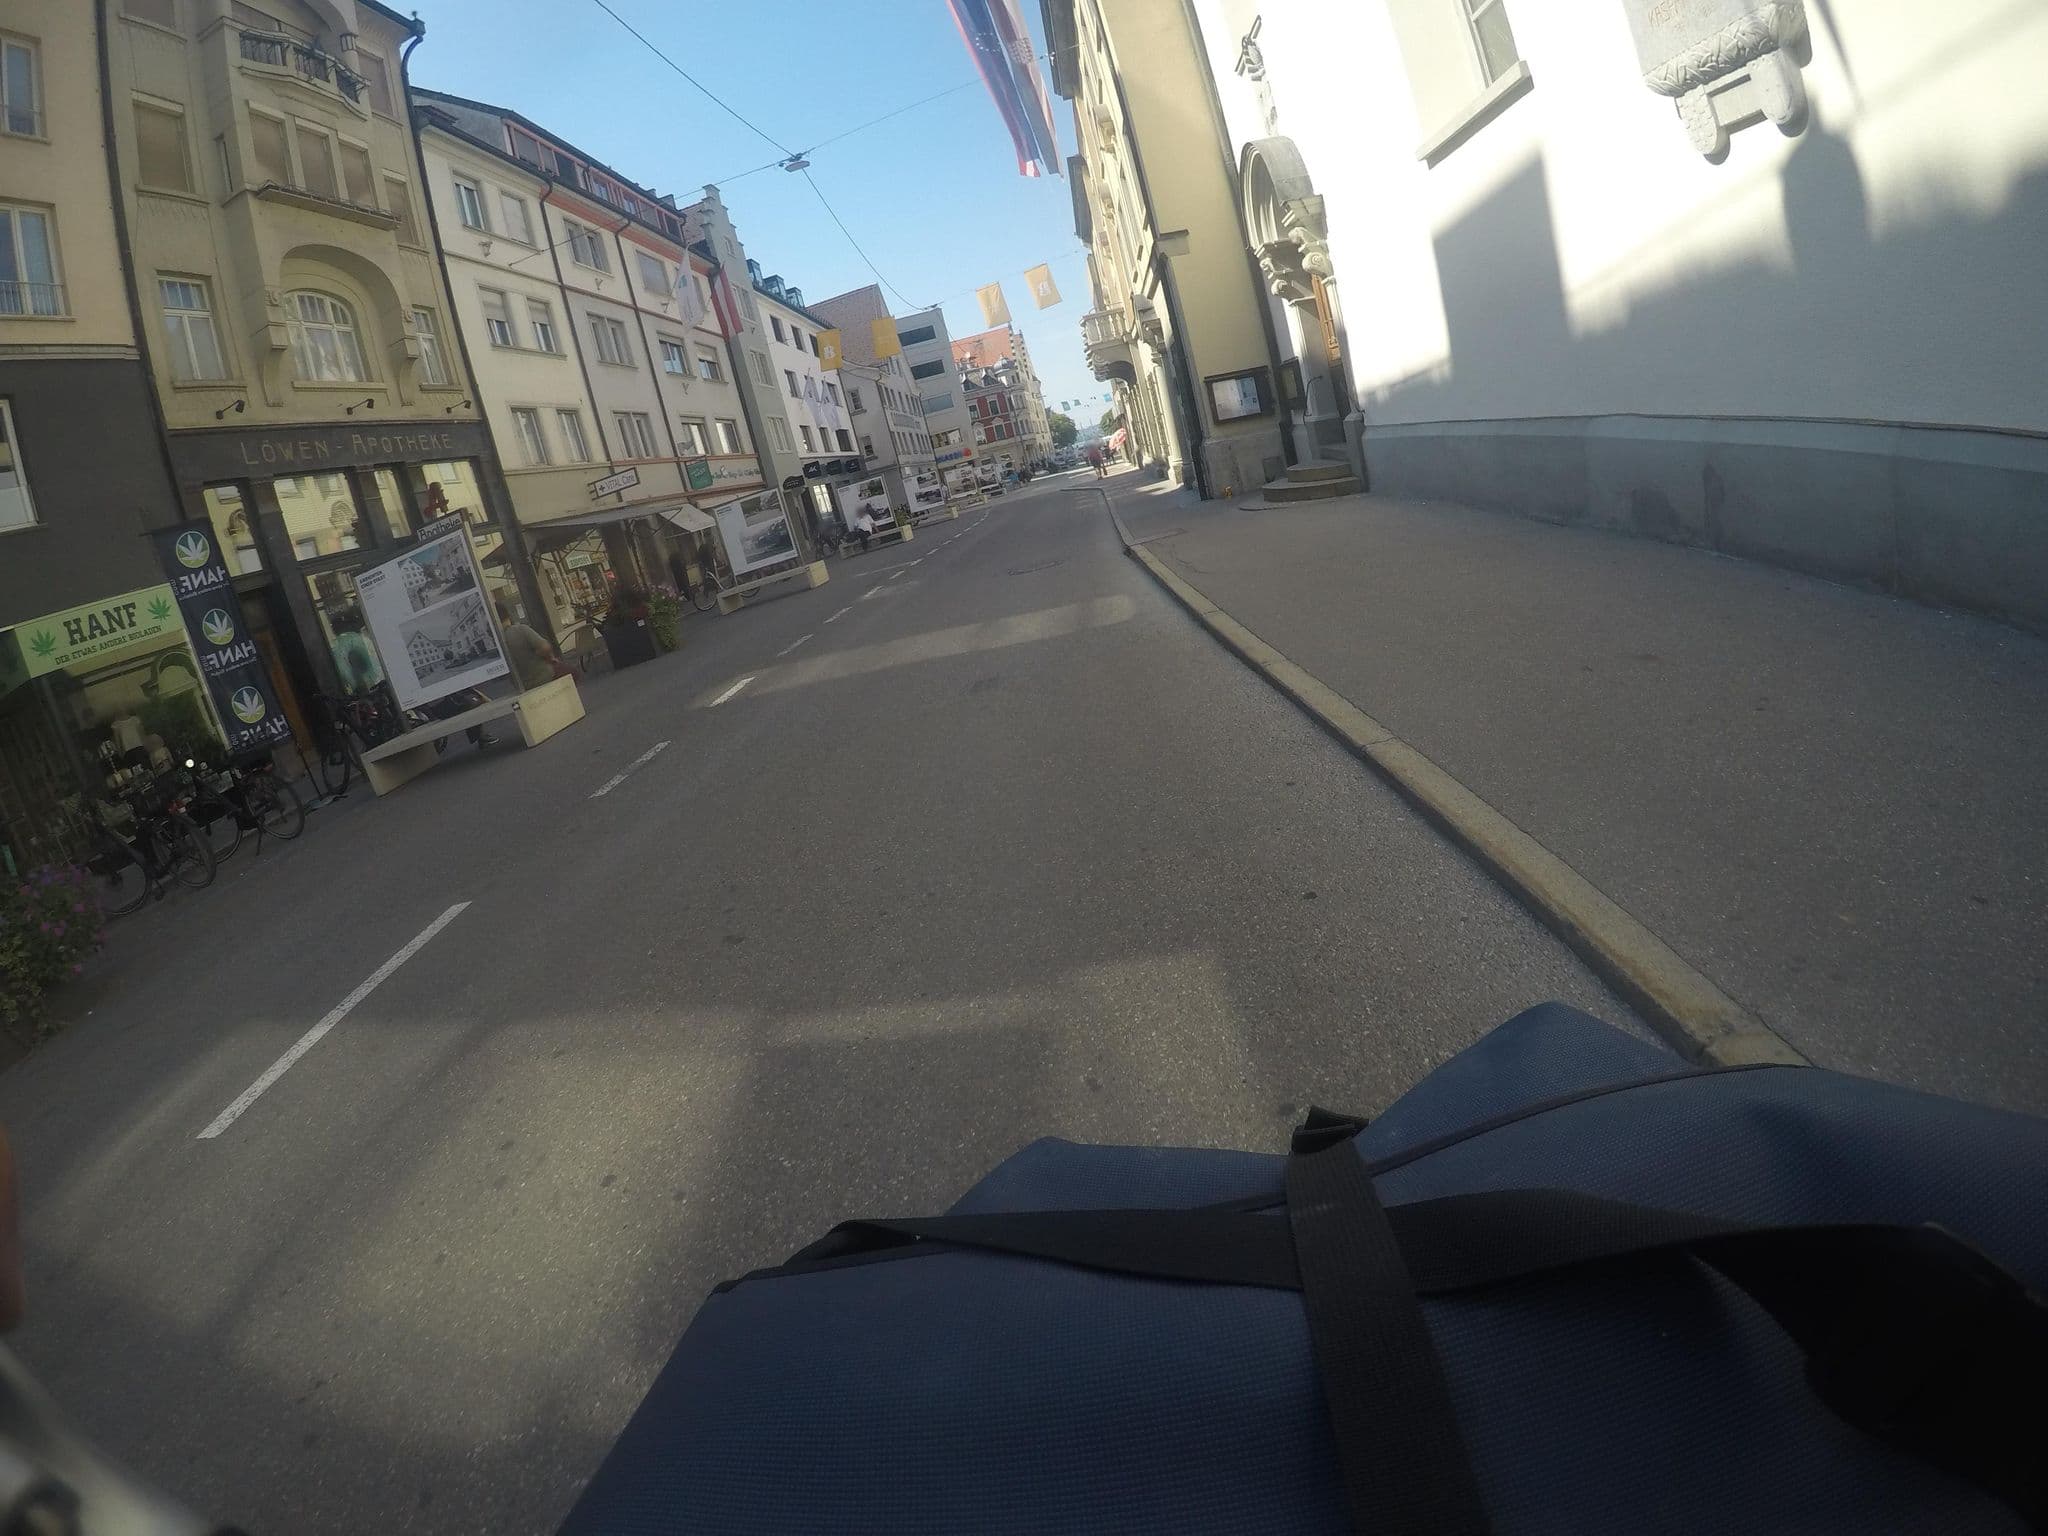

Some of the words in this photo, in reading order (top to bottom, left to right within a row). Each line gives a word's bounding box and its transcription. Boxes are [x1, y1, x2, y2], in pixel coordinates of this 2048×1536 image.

[241, 440, 329, 465] LÖWEN
[351, 433, 453, 456] APOTHEKE
[63, 602, 137, 646] HANF
[55, 655, 70, 665] DER
[73, 645, 97, 660] ETWAS
[99, 635, 127, 650] ANDERE
[129, 625, 162, 641] BIOLADEN
